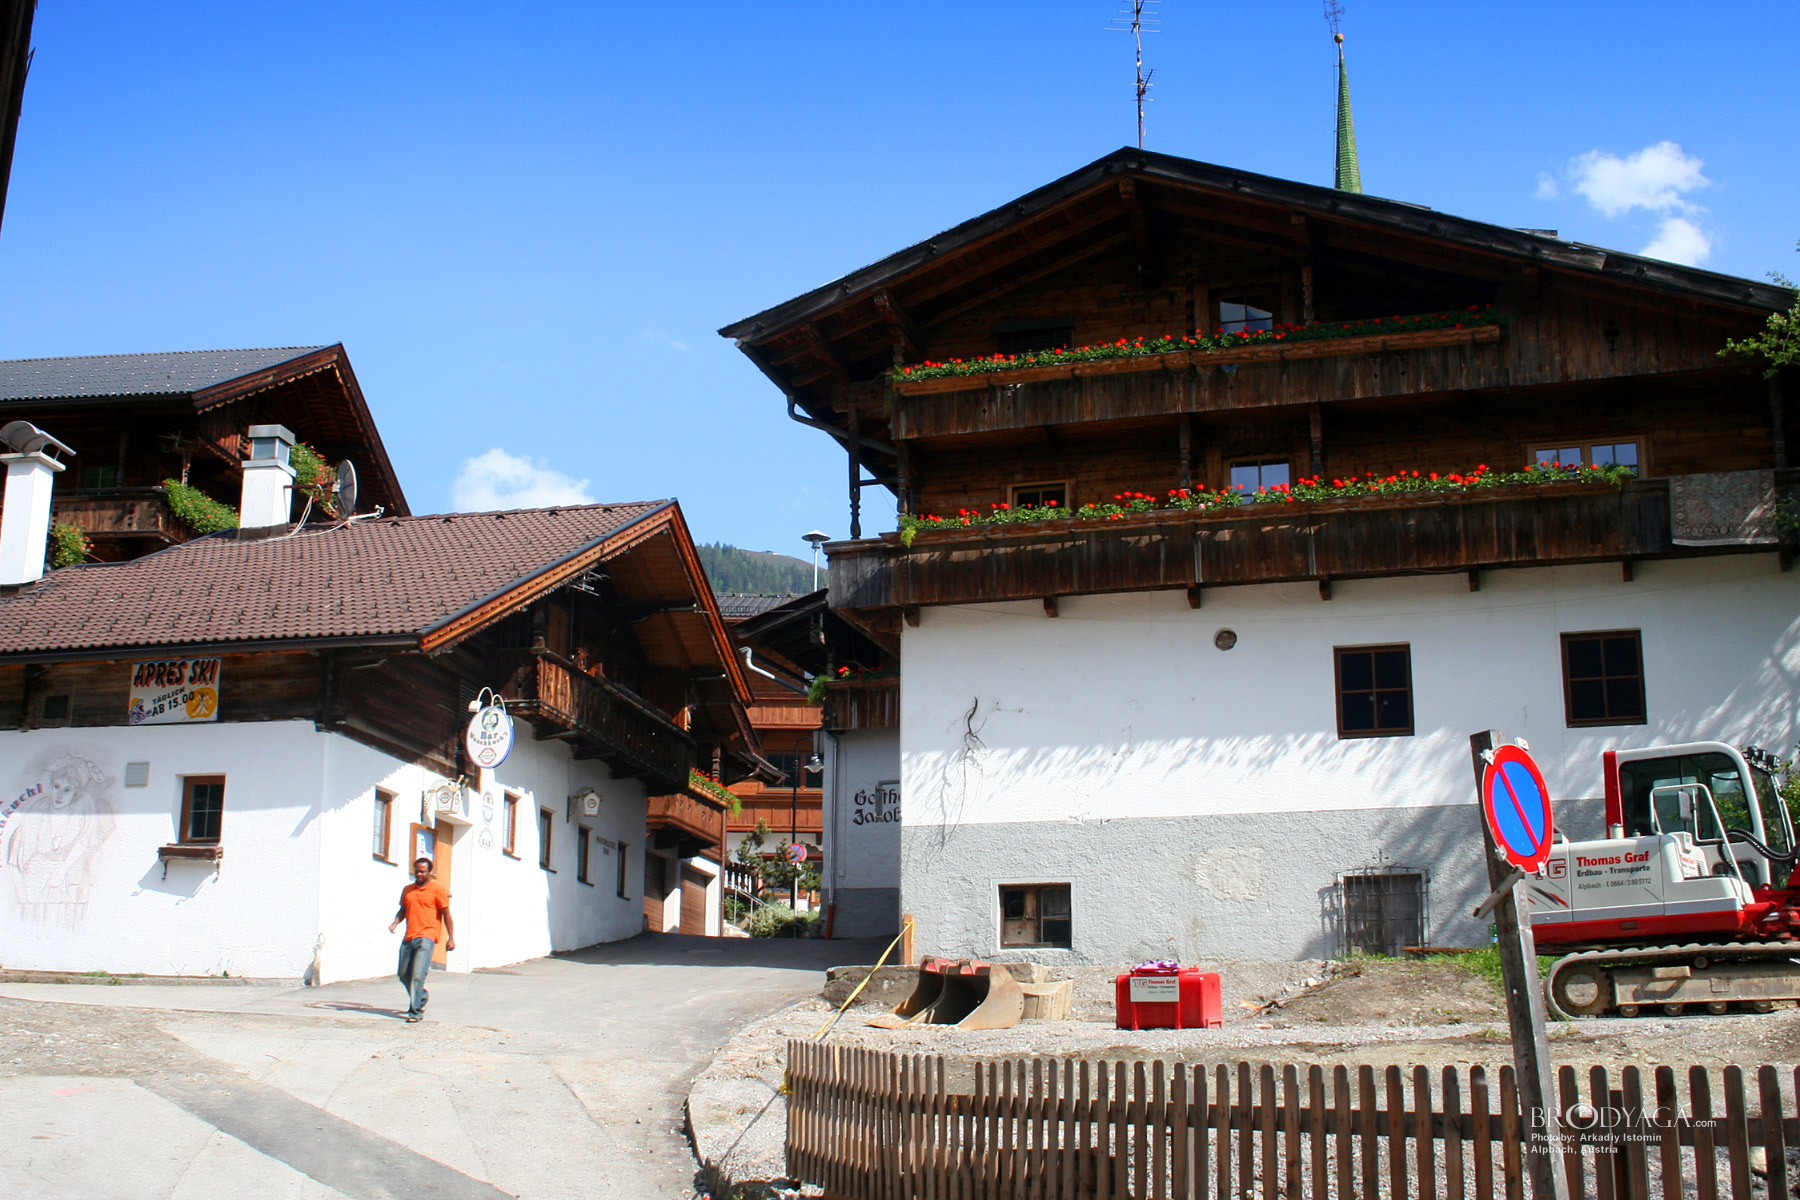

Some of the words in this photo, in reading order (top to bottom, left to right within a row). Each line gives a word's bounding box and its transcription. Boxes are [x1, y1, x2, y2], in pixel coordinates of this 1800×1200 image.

[133, 661, 188, 688] APRES
[188, 659, 219, 685] SKI
[151, 703, 165, 717] AB
[168, 691, 195, 710] 15.00
[480, 731, 499, 740] Bar
[853, 806, 902, 825] Jaob
[1576, 856, 1621, 867] Thomas
[1625, 851, 1649, 863] Graf
[1577, 869, 1602, 877] Erdbau
[1609, 865, 1650, 874] Transporte
[1578, 882, 1601, 890] Alpbach
